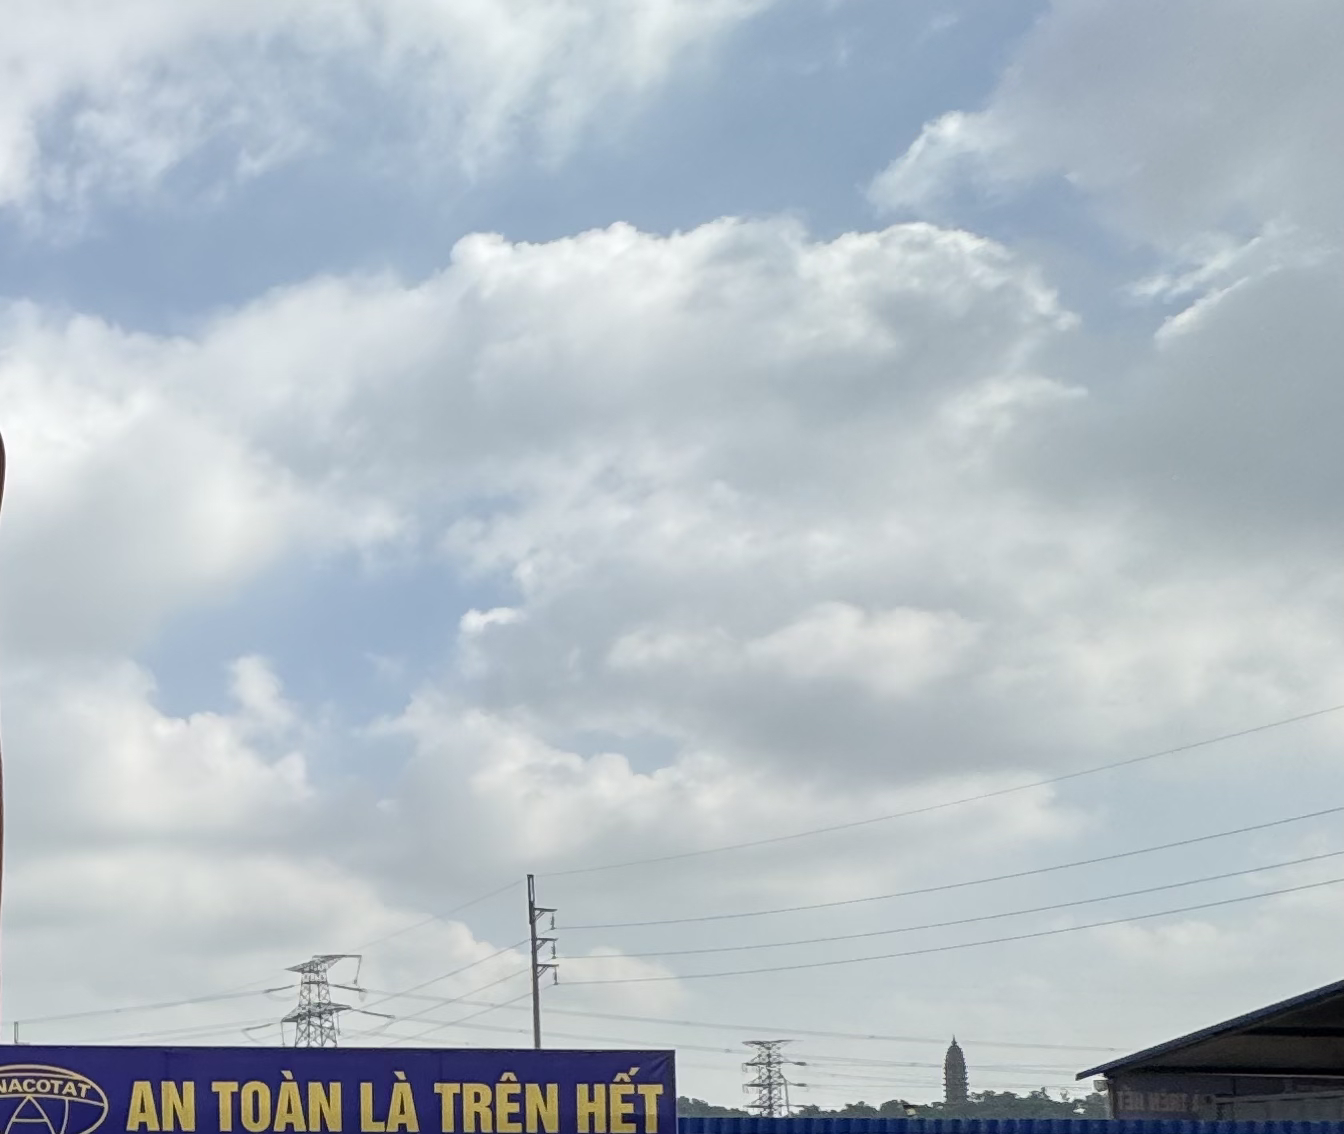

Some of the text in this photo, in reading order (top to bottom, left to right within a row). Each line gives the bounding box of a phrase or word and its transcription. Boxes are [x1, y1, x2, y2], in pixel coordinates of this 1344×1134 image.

[126, 1067, 664, 1134] AN TOÀN LÀ TRÊN HẾT
